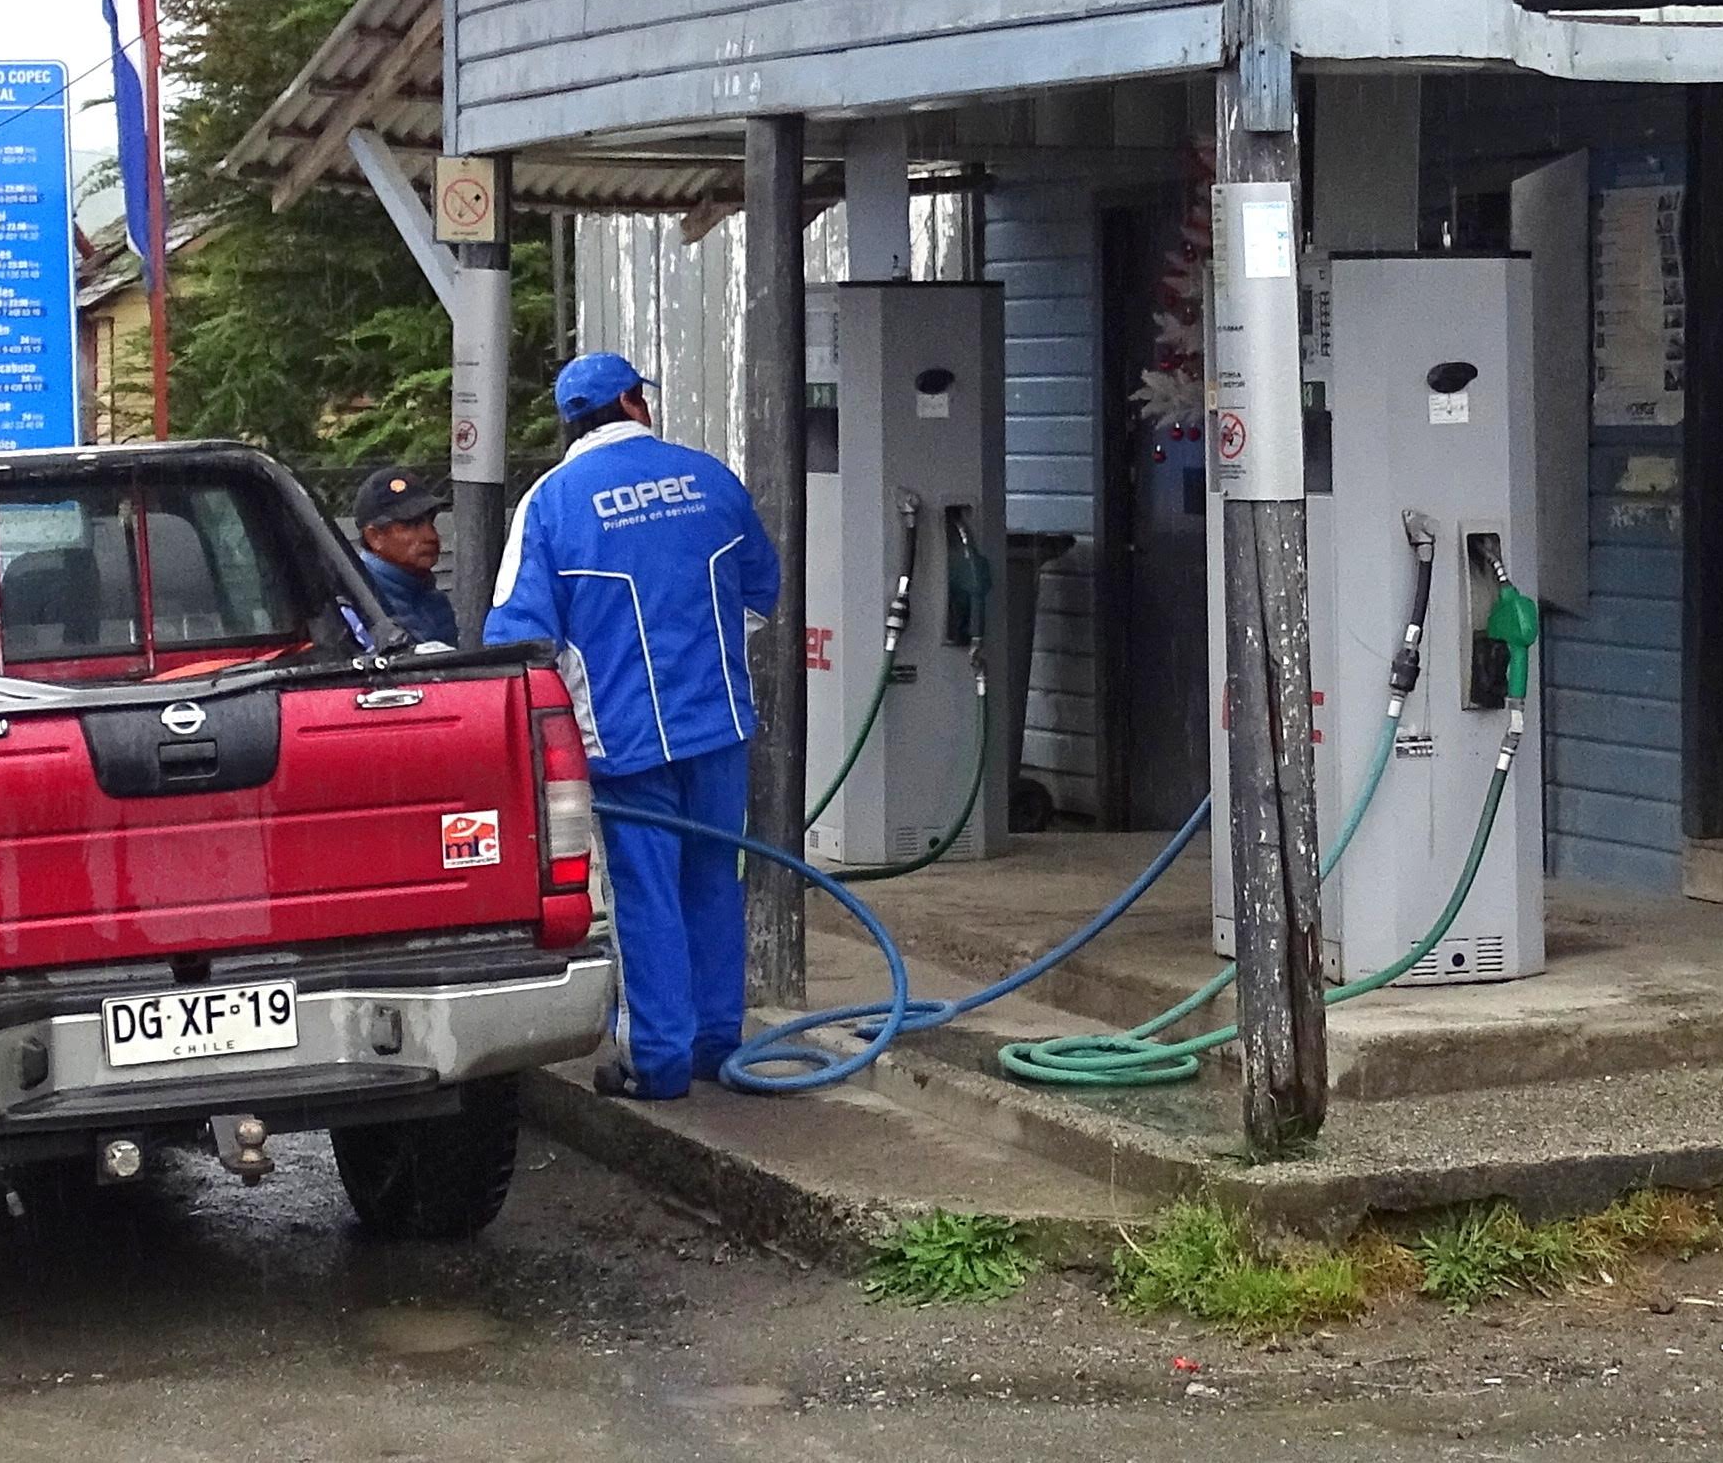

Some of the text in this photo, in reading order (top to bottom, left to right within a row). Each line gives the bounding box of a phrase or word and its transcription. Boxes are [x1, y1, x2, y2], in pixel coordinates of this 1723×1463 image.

[8, 70, 52, 83] COPEC
[592, 475, 702, 518] COPEC
[603, 513, 647, 531] Primera
[173, 1039, 237, 1056] CHILE
